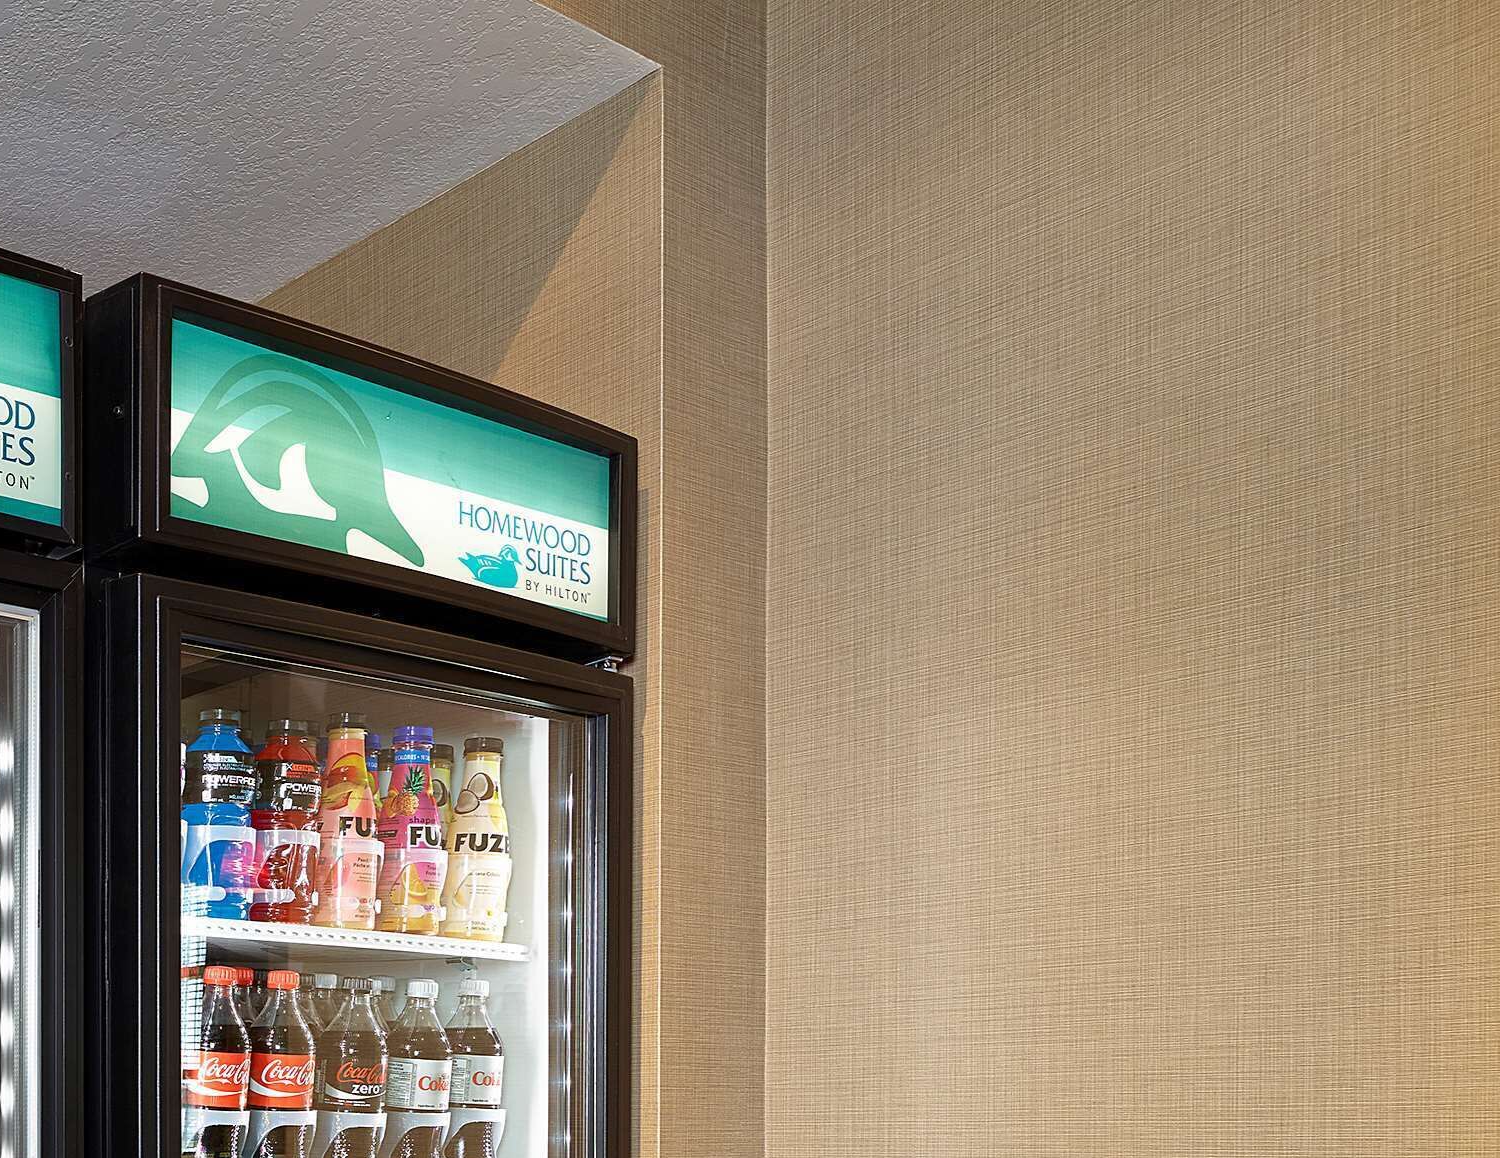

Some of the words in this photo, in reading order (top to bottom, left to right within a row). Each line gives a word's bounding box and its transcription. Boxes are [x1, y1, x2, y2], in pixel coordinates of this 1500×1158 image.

[459, 501, 591, 557] HOMEWOOD
[525, 547, 591, 585] SUITES
[525, 580, 540, 592] BY
[545, 585, 588, 604] HILTON
[351, 1083, 380, 1095] zero
[472, 1071, 500, 1086] Co
